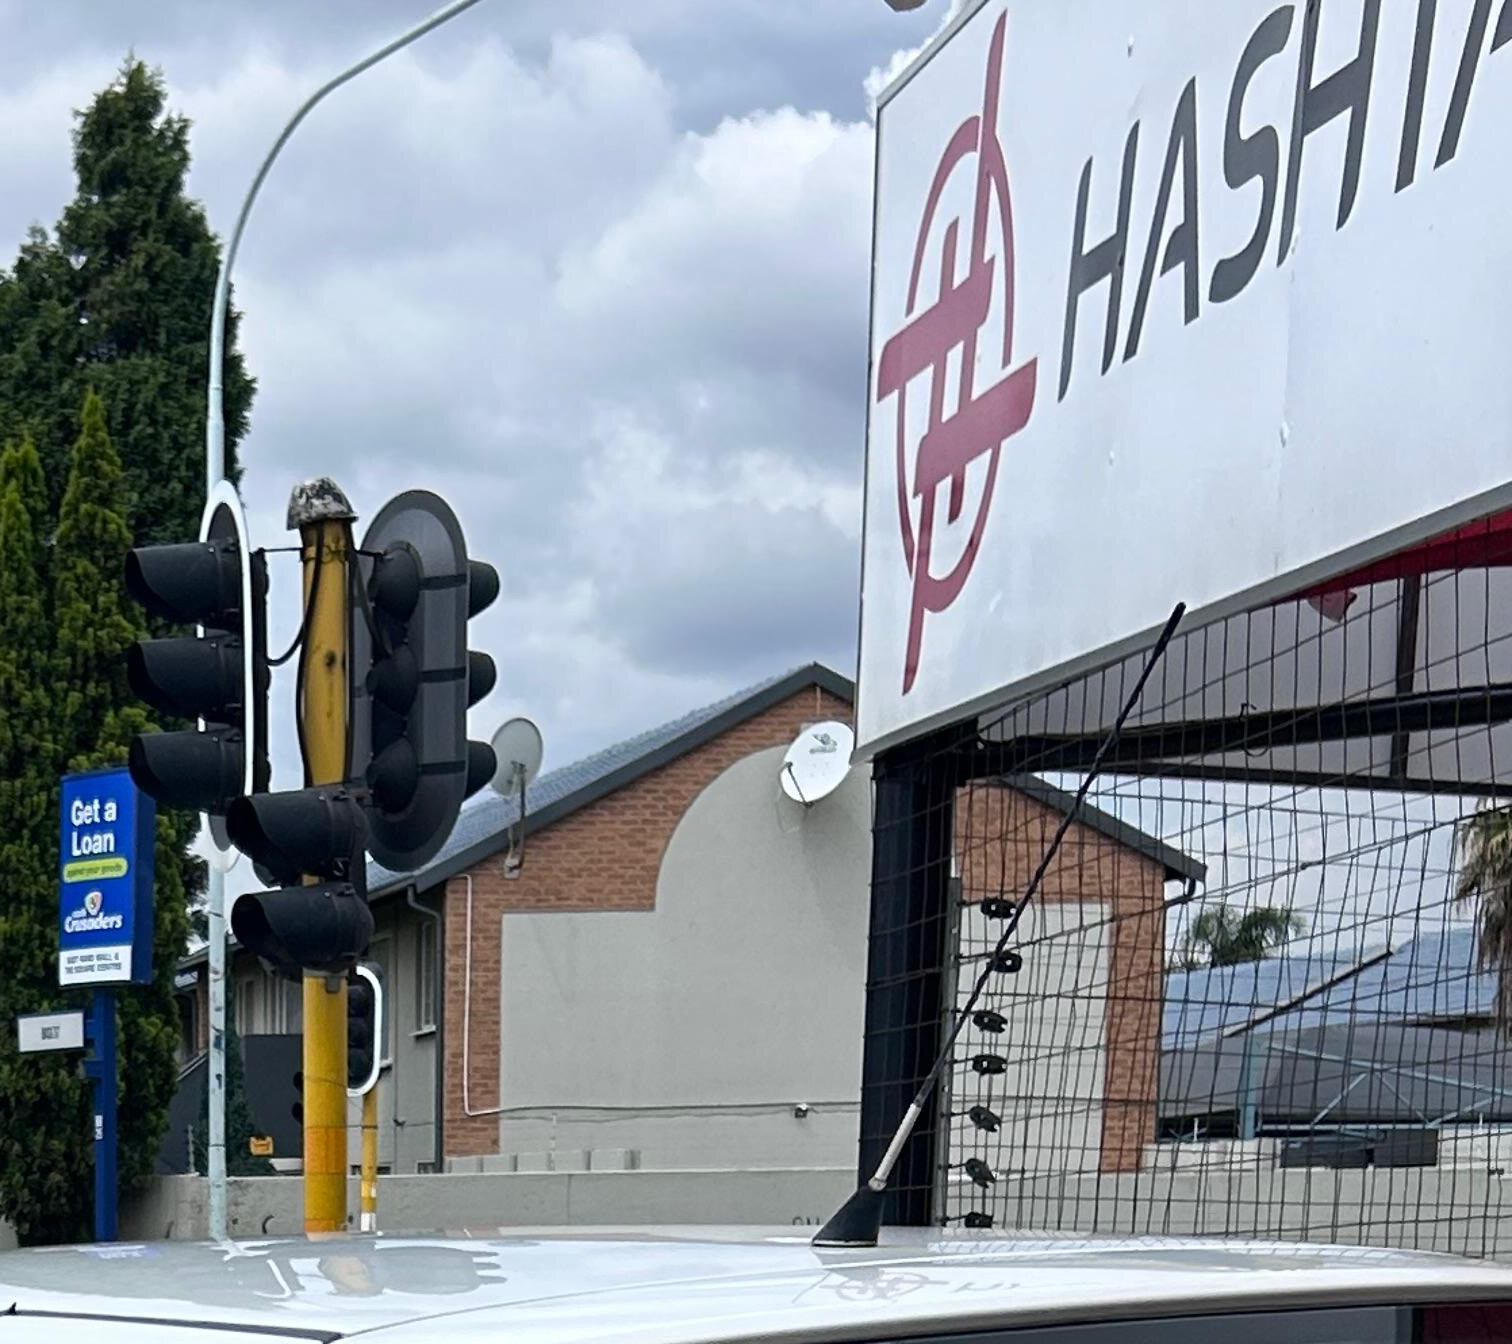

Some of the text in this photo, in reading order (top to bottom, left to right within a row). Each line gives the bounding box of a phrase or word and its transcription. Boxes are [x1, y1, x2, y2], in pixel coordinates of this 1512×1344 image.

[71, 798, 117, 826] Get a
[71, 831, 115, 857] Loan
